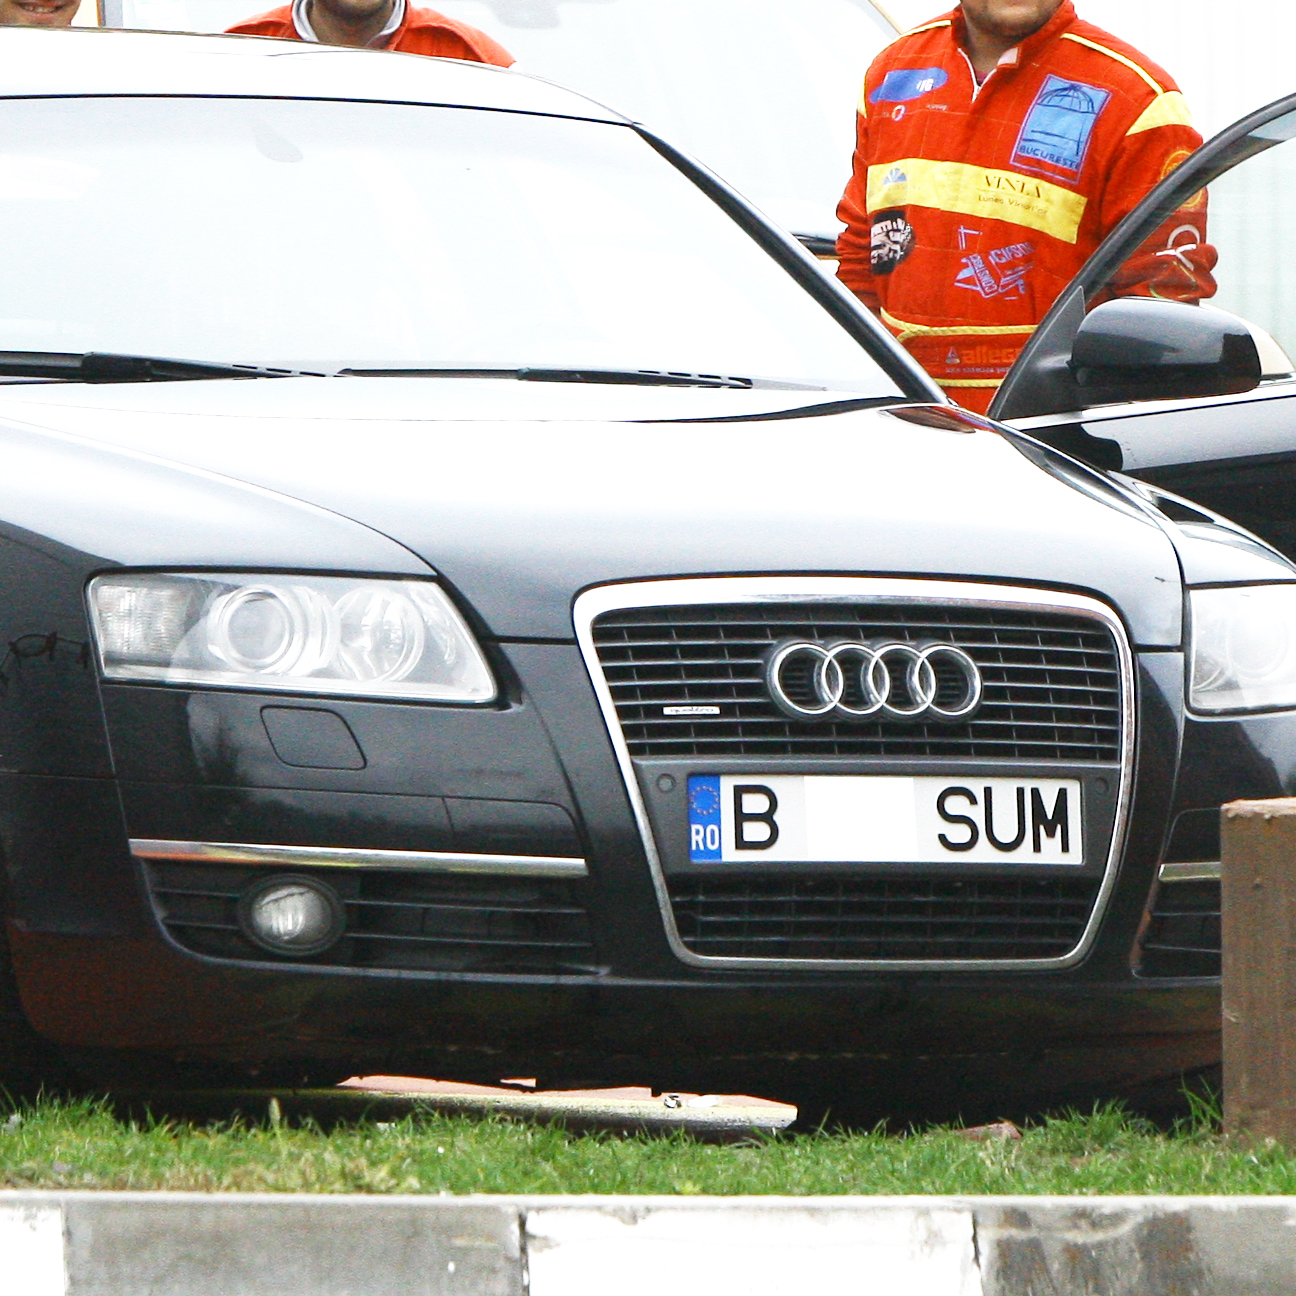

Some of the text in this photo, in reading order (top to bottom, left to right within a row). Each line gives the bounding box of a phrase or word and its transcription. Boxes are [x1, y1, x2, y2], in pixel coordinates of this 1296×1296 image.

[690, 824, 720, 851] RO
[733, 785, 1070, 853] B SUM
